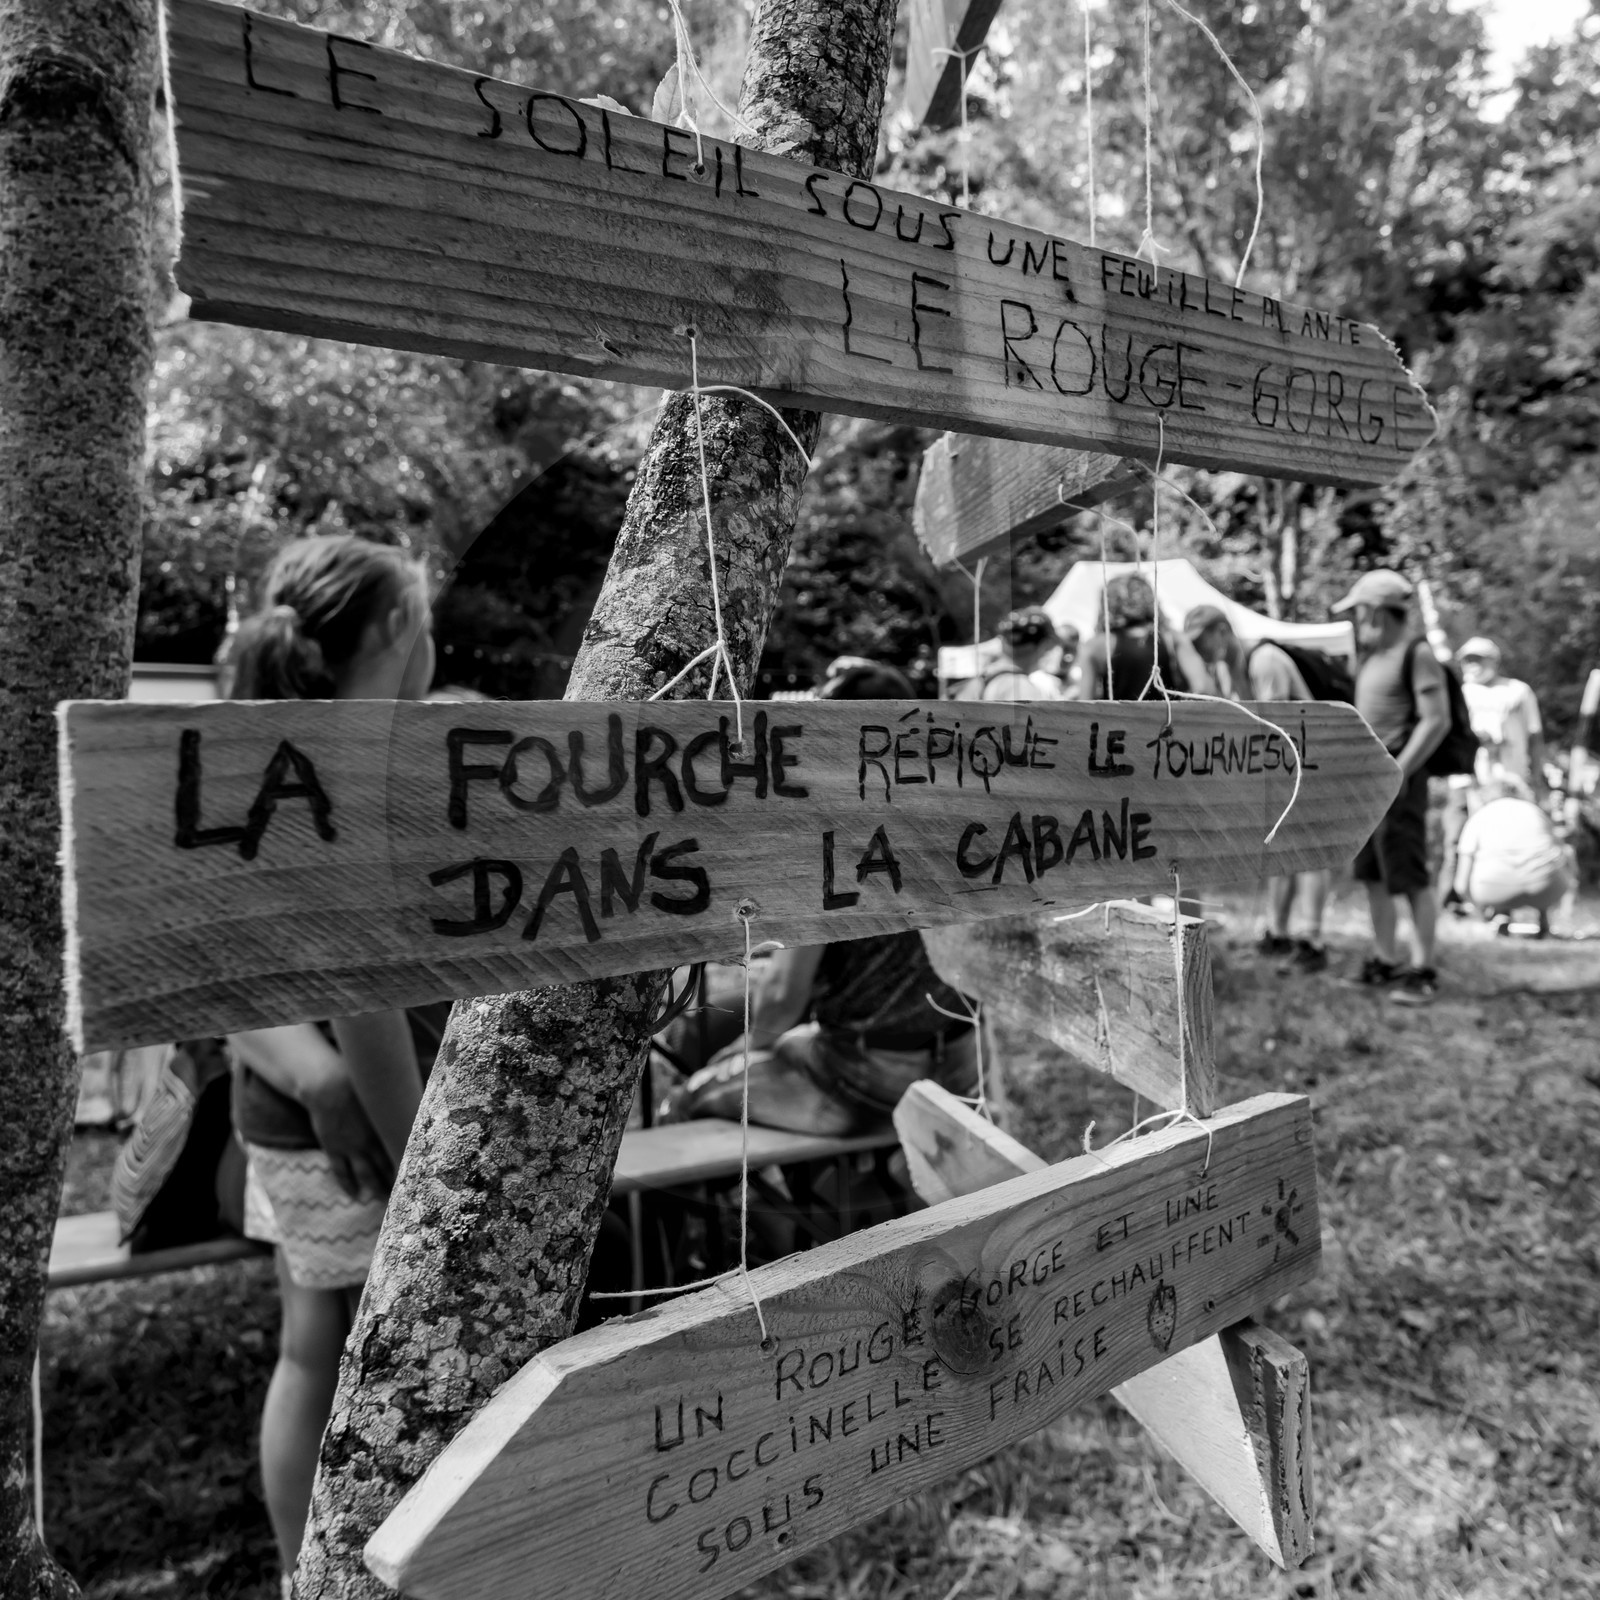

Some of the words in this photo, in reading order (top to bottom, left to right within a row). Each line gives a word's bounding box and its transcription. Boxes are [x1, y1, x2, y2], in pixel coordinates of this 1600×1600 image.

[244, 12, 382, 115] LE
[474, 77, 759, 199] SOLEIL
[803, 173, 961, 250] SOUS
[988, 230, 1069, 281] UNE
[839, 258, 953, 373] LE
[175, 728, 337, 860] LA
[447, 710, 809, 829] FOURCHE
[1089, 722, 1134, 778] LE
[1147, 716, 1318, 780] TOURNESOL
[429, 830, 711, 942] DANS
[822, 825, 903, 911] LA
[956, 797, 1158, 884] CABANE
[655, 1391, 724, 1452] UN
[1096, 1211, 1134, 1252] ET
[1166, 1184, 1219, 1227] UNE
[989, 1313, 1023, 1362] SE
[1054, 1212, 1251, 1326] RECHAUFFENT
[697, 1474, 824, 1573] SOUS
[870, 1412, 945, 1474] UNE
